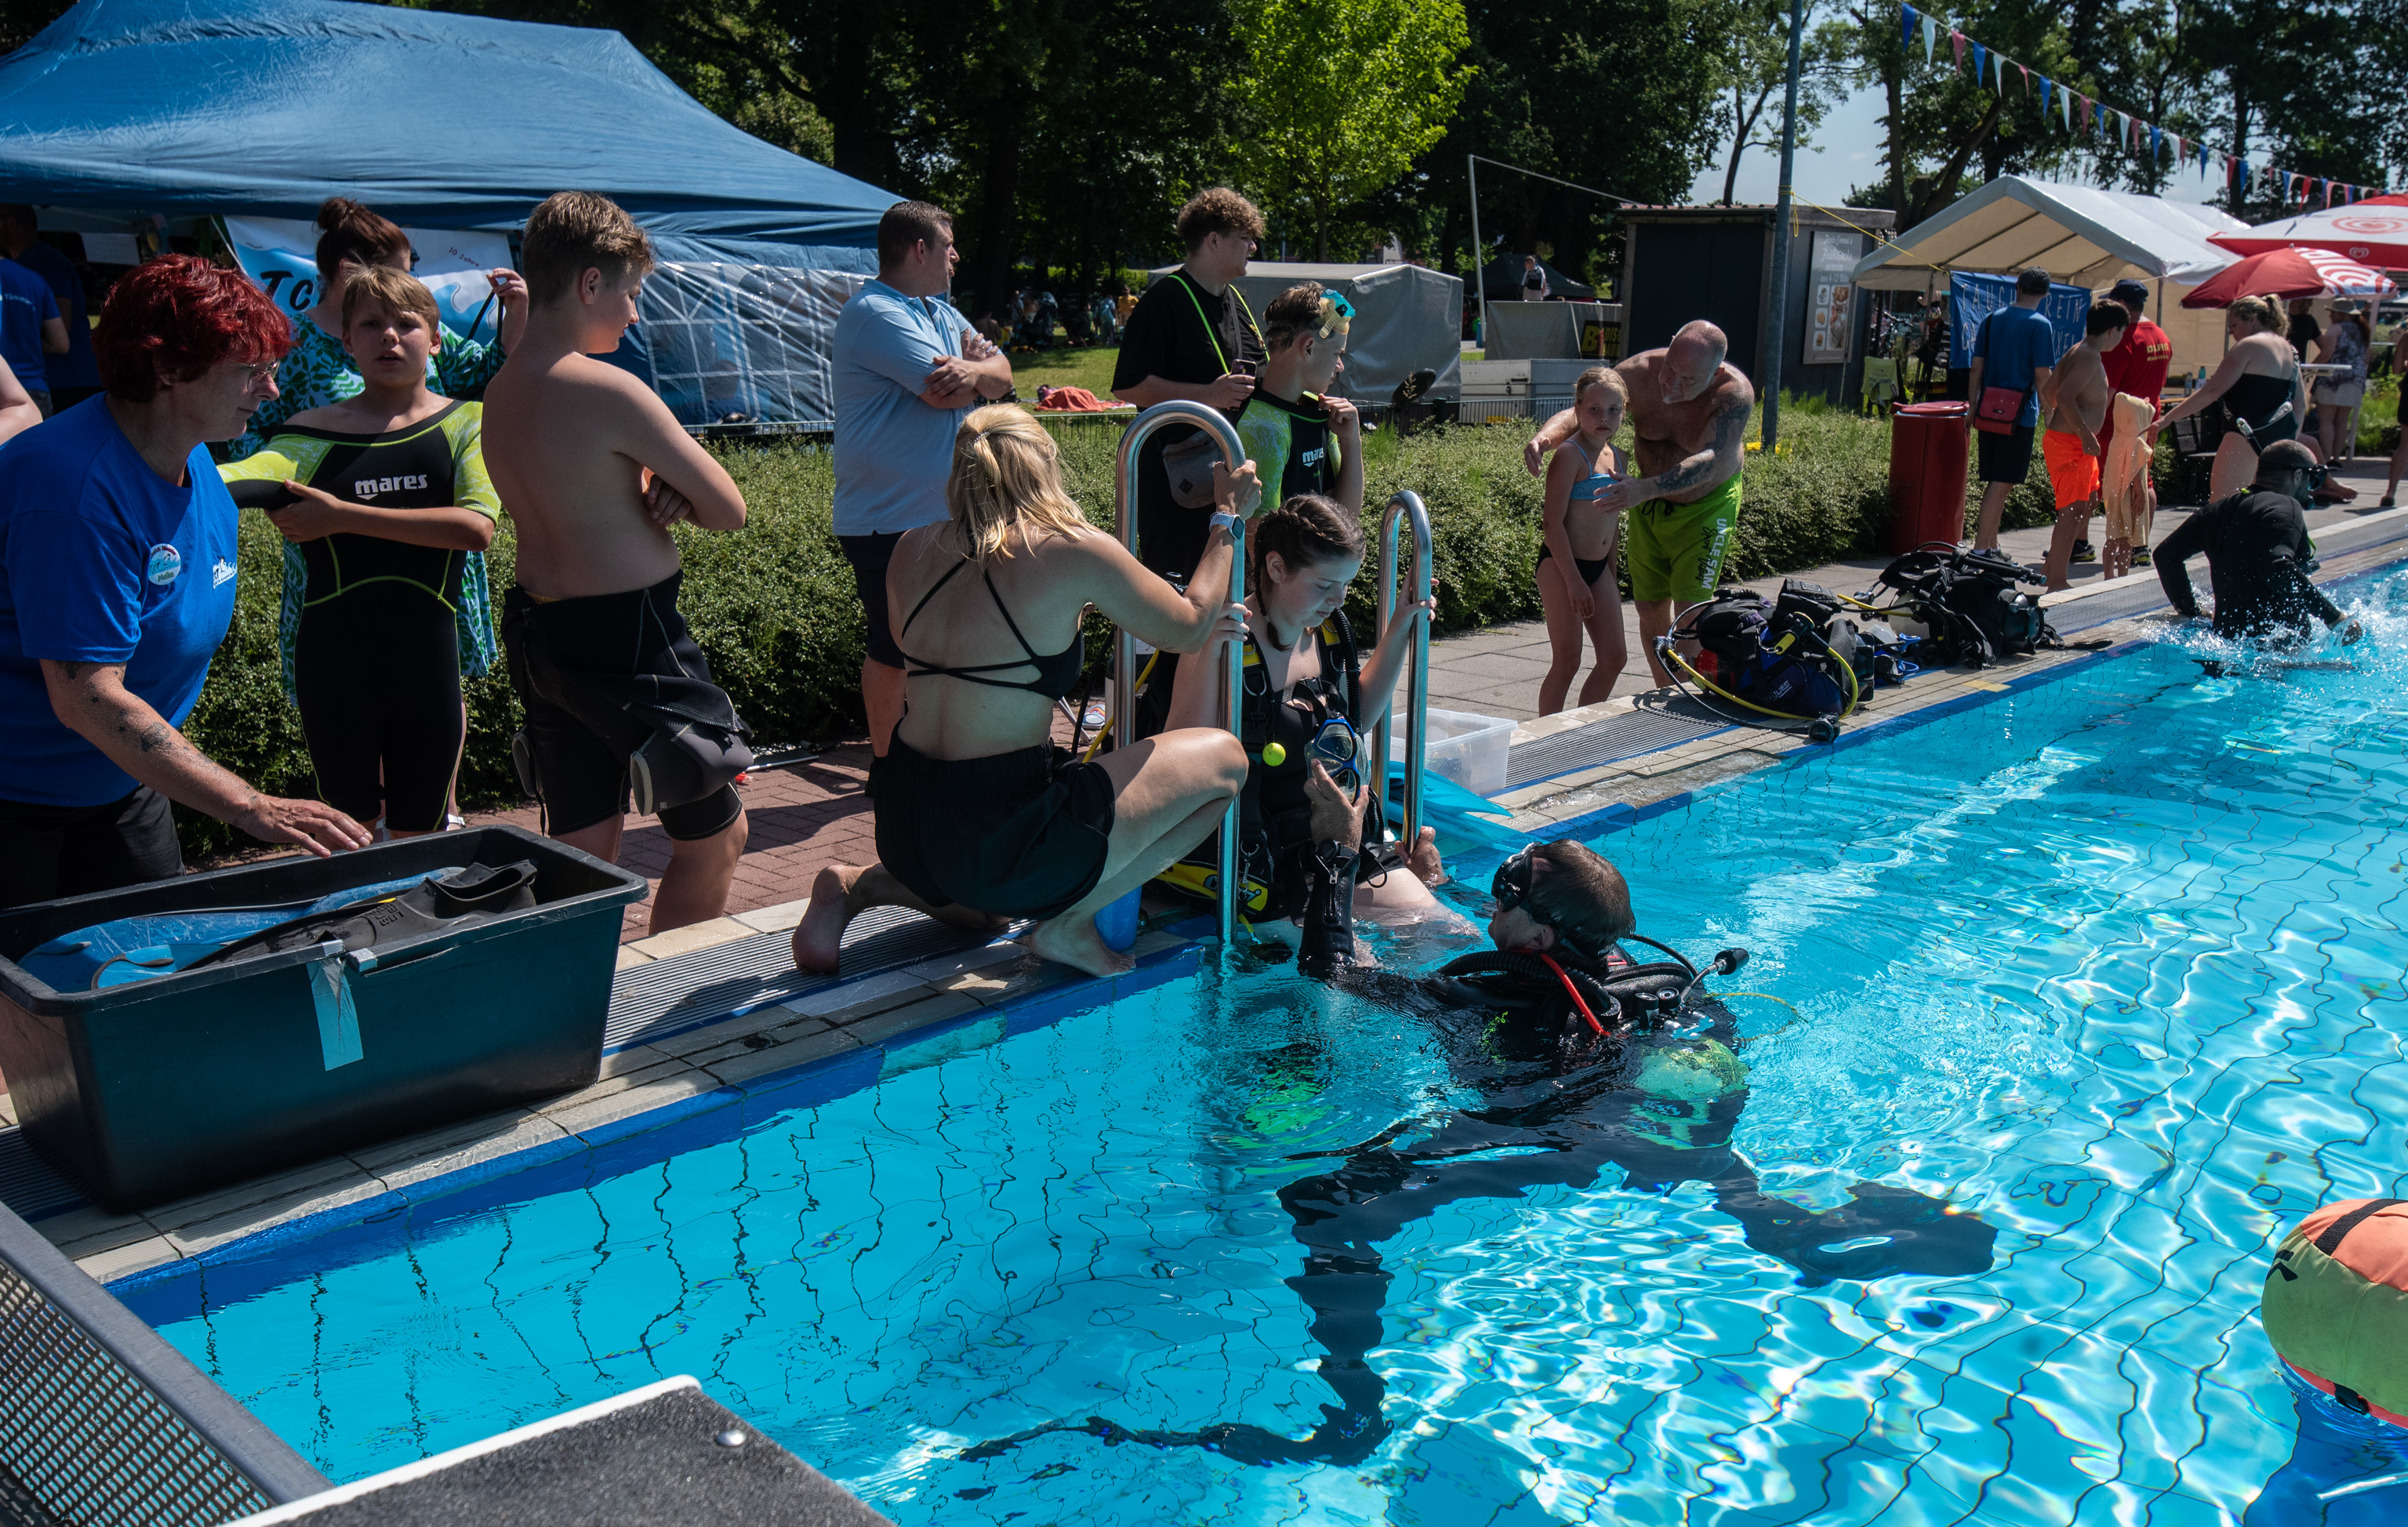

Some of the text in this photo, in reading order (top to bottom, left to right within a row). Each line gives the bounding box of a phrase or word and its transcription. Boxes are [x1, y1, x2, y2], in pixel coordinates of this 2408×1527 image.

[449, 246, 458, 256] 10
[260, 270, 328, 311] TC
[355, 474, 427, 495] mares
[1710, 518, 1727, 557] UNCLE
[1702, 558, 1718, 589] SAM
